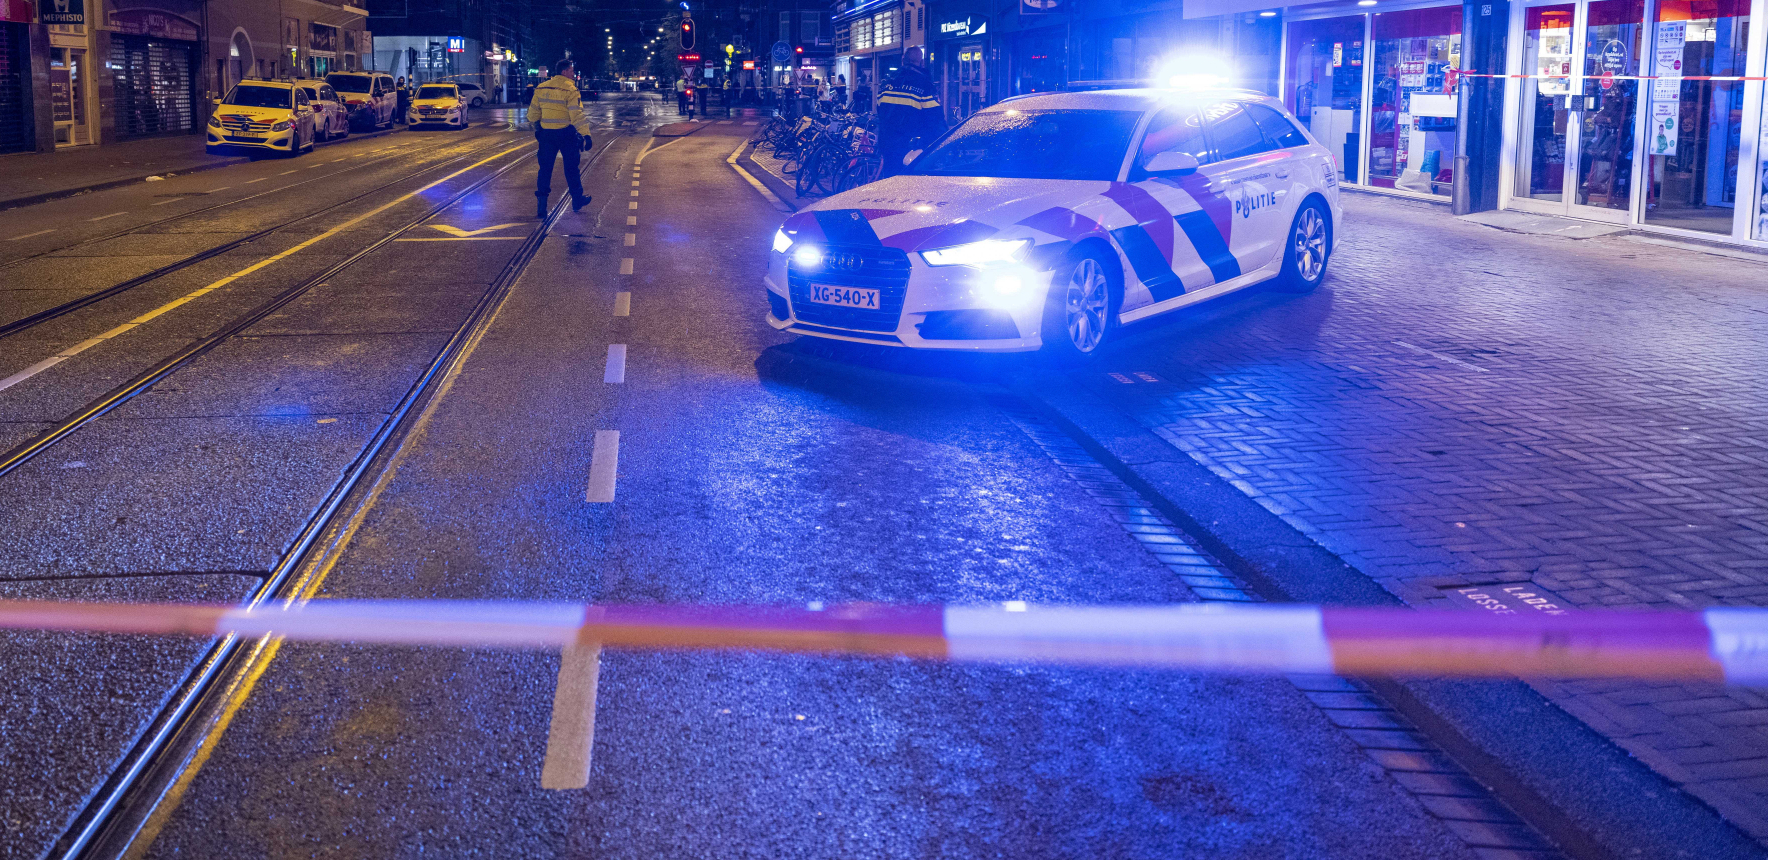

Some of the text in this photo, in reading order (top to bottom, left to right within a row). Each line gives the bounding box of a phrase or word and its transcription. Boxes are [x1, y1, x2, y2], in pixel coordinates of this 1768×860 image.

[43, 13, 83, 22] MEPHISTO
[450, 38, 461, 49] M
[1235, 191, 1276, 219] POLITIE
[813, 285, 876, 307] XG-540-X
